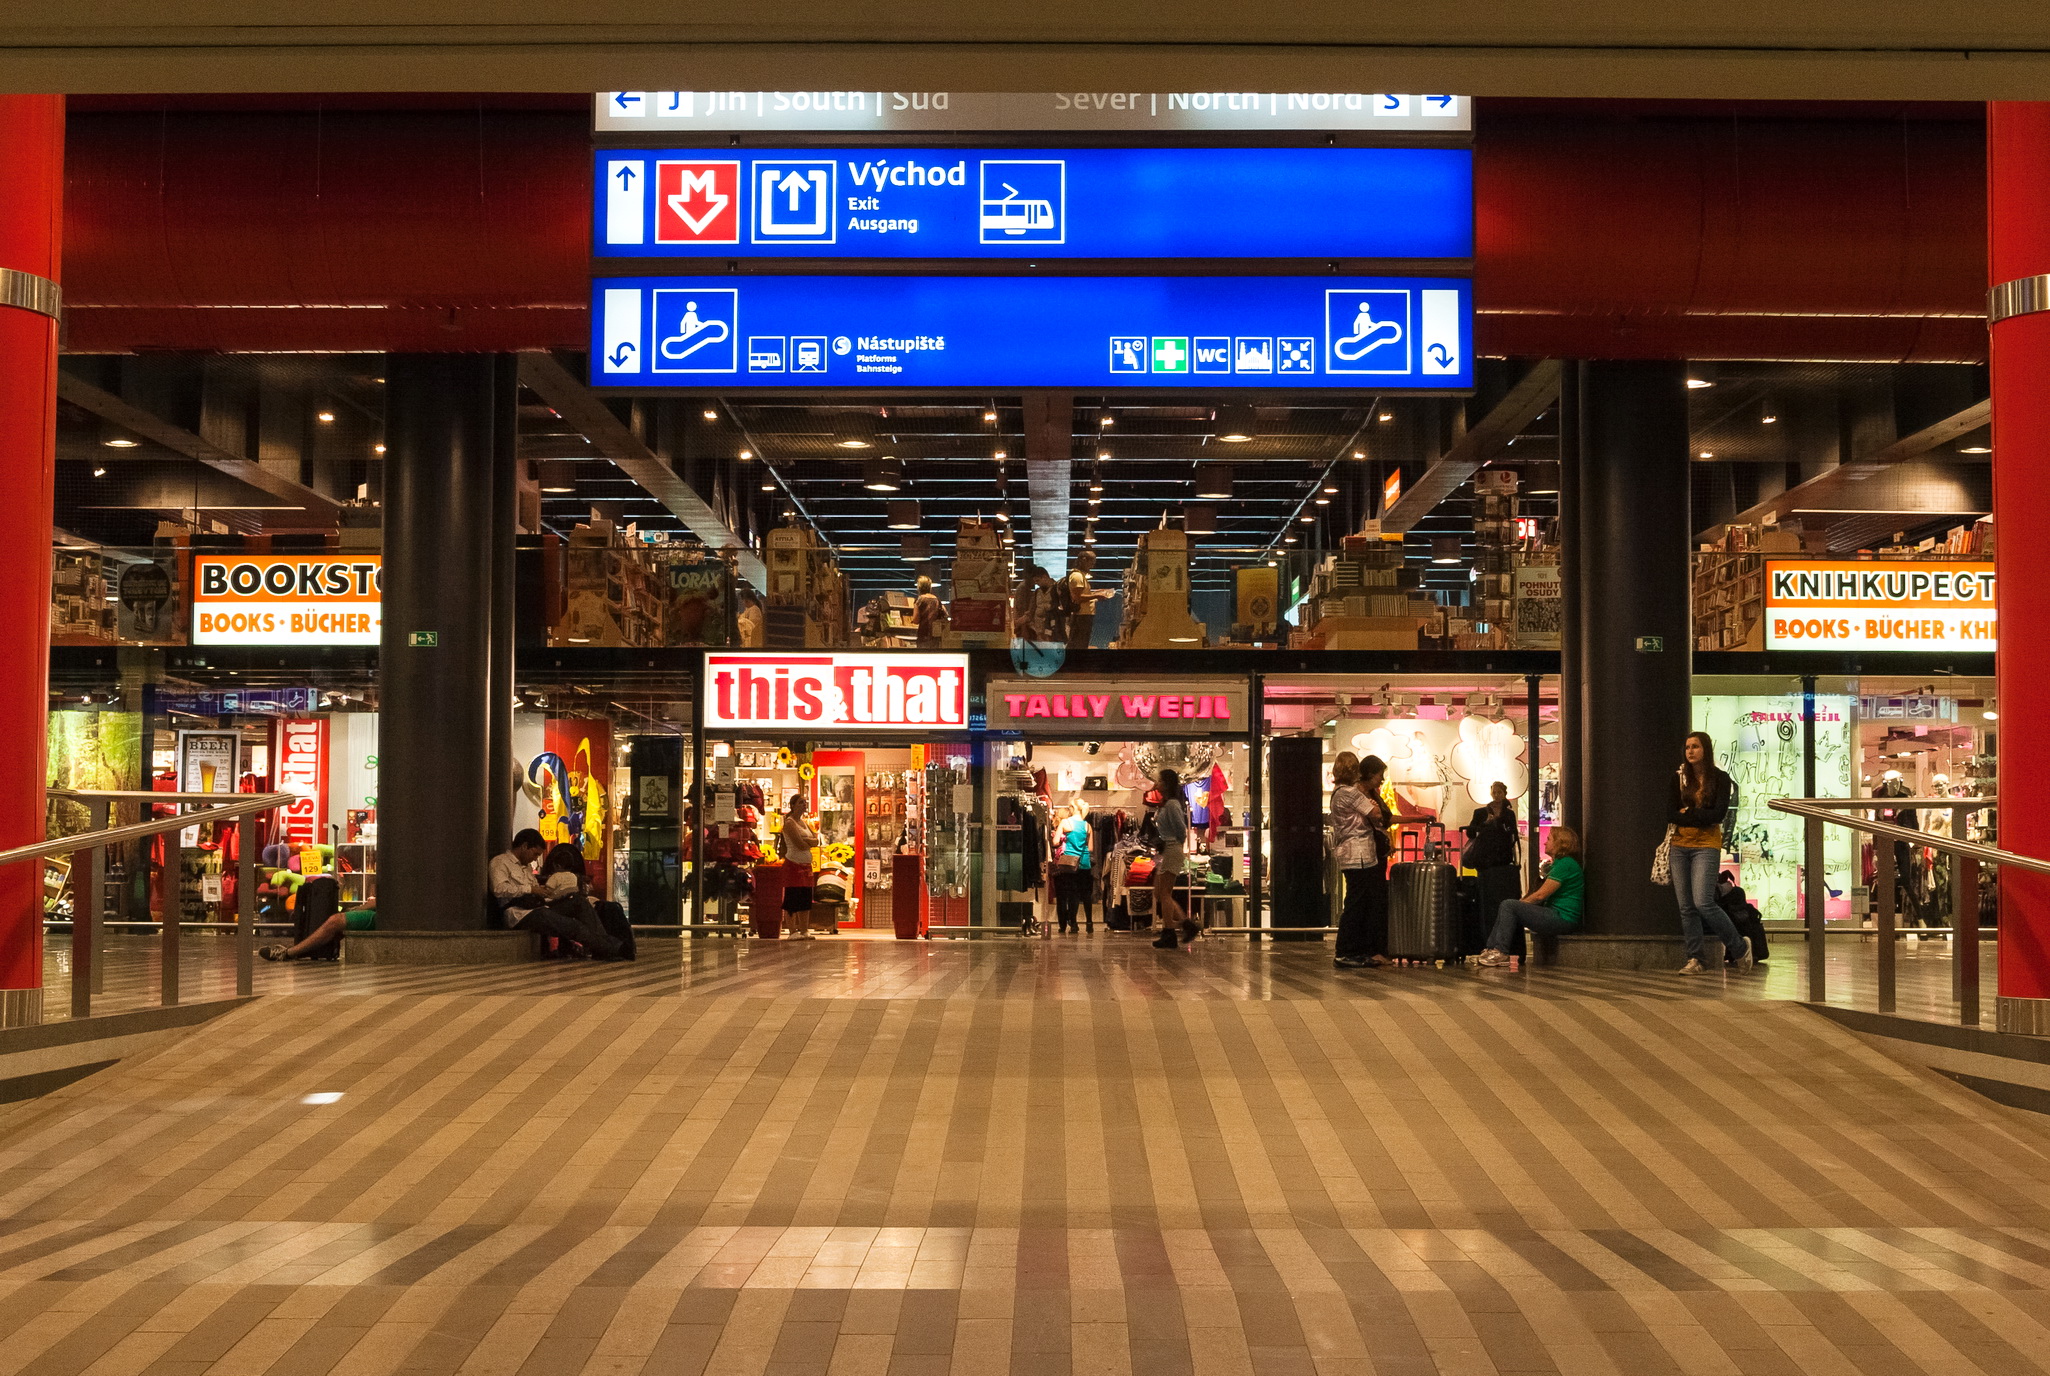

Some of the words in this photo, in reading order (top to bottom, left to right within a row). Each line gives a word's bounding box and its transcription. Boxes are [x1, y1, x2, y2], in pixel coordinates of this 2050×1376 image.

[773, 91, 866, 111] South
[1055, 92, 1141, 110] Sever
[1168, 92, 1260, 110] North
[1287, 92, 1362, 110] Nord
[848, 159, 966, 192] Východ
[847, 196, 880, 211] Exit
[847, 217, 918, 234] Ausgang
[857, 336, 945, 354] Nástupiště
[857, 354, 897, 363] Platforms
[1197, 348, 1227, 362] WC
[857, 365, 903, 375] Bahnsteige
[202, 564, 382, 595] BOOKST
[670, 570, 721, 589] LORAX
[1526, 589, 1559, 597] OSUDY
[200, 612, 275, 633] BOOKS
[291, 608, 371, 633] BÜCHER
[1774, 619, 1850, 640] BOOKS
[1865, 614, 1945, 640] BÜCHER
[1004, 694, 1111, 718] TALLY
[189, 742, 228, 750] BEER
[866, 871, 878, 880] 49
